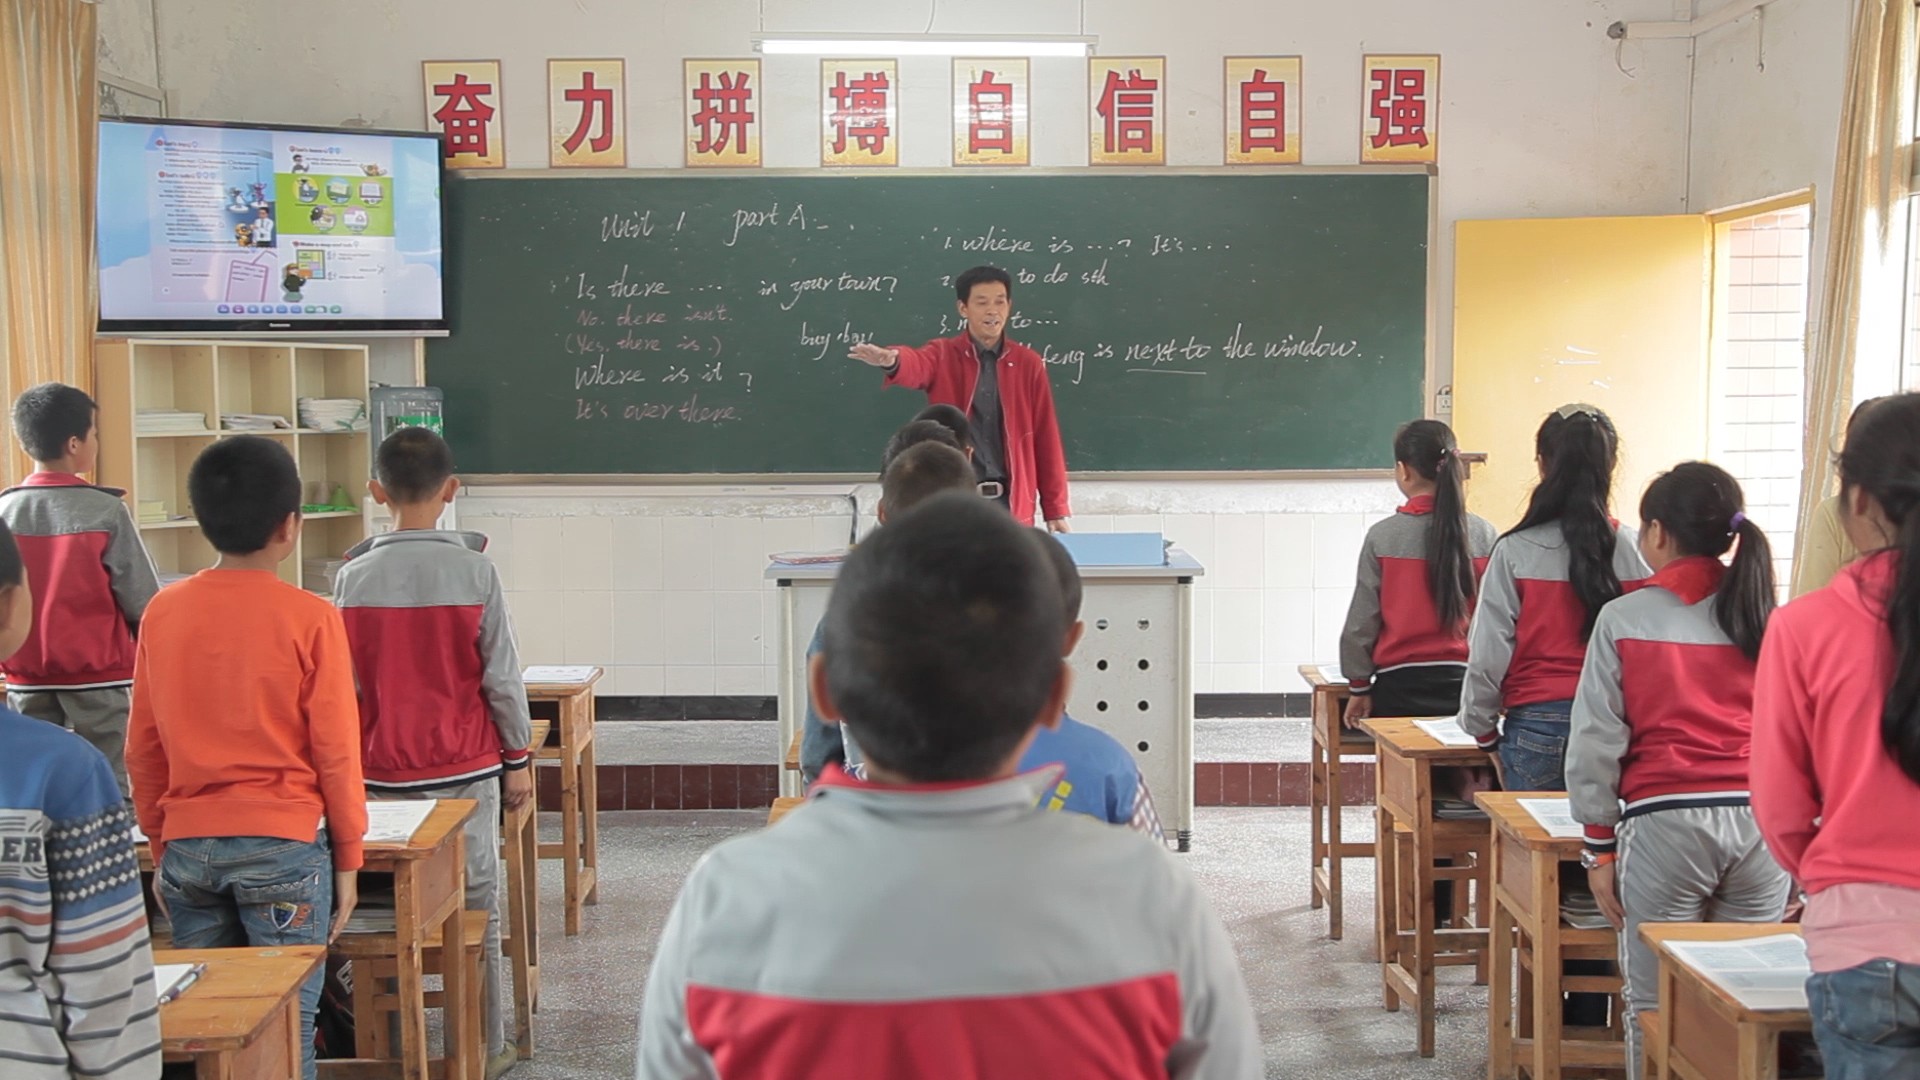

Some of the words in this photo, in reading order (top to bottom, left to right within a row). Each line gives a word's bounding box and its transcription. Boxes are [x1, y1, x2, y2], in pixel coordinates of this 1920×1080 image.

[434, 74, 494, 158] 奋
[562, 71, 613, 155] 力
[692, 71, 754, 155] 拼
[969, 70, 1013, 154] 自
[1096, 69, 1158, 153] 信
[1241, 69, 1285, 153] 自
[1370, 69, 1429, 149] 强
[601, 210, 655, 242] Unit
[722, 202, 779, 247] part
[1047, 236, 1074, 253] is
[1016, 267, 1036, 284] to
[1043, 262, 1069, 284] do
[576, 272, 597, 300] Is
[607, 263, 671, 298] there
[757, 280, 778, 296] in
[779, 276, 834, 311] your
[616, 303, 668, 326] there
[616, 329, 662, 351] there
[800, 321, 831, 361] buy
[1093, 343, 1114, 358] is
[1124, 338, 1177, 367] next
[1180, 335, 1211, 361] to
[1222, 322, 1256, 359] the
[661, 365, 690, 383] is
[575, 398, 608, 420] It's
[623, 402, 674, 420] over
